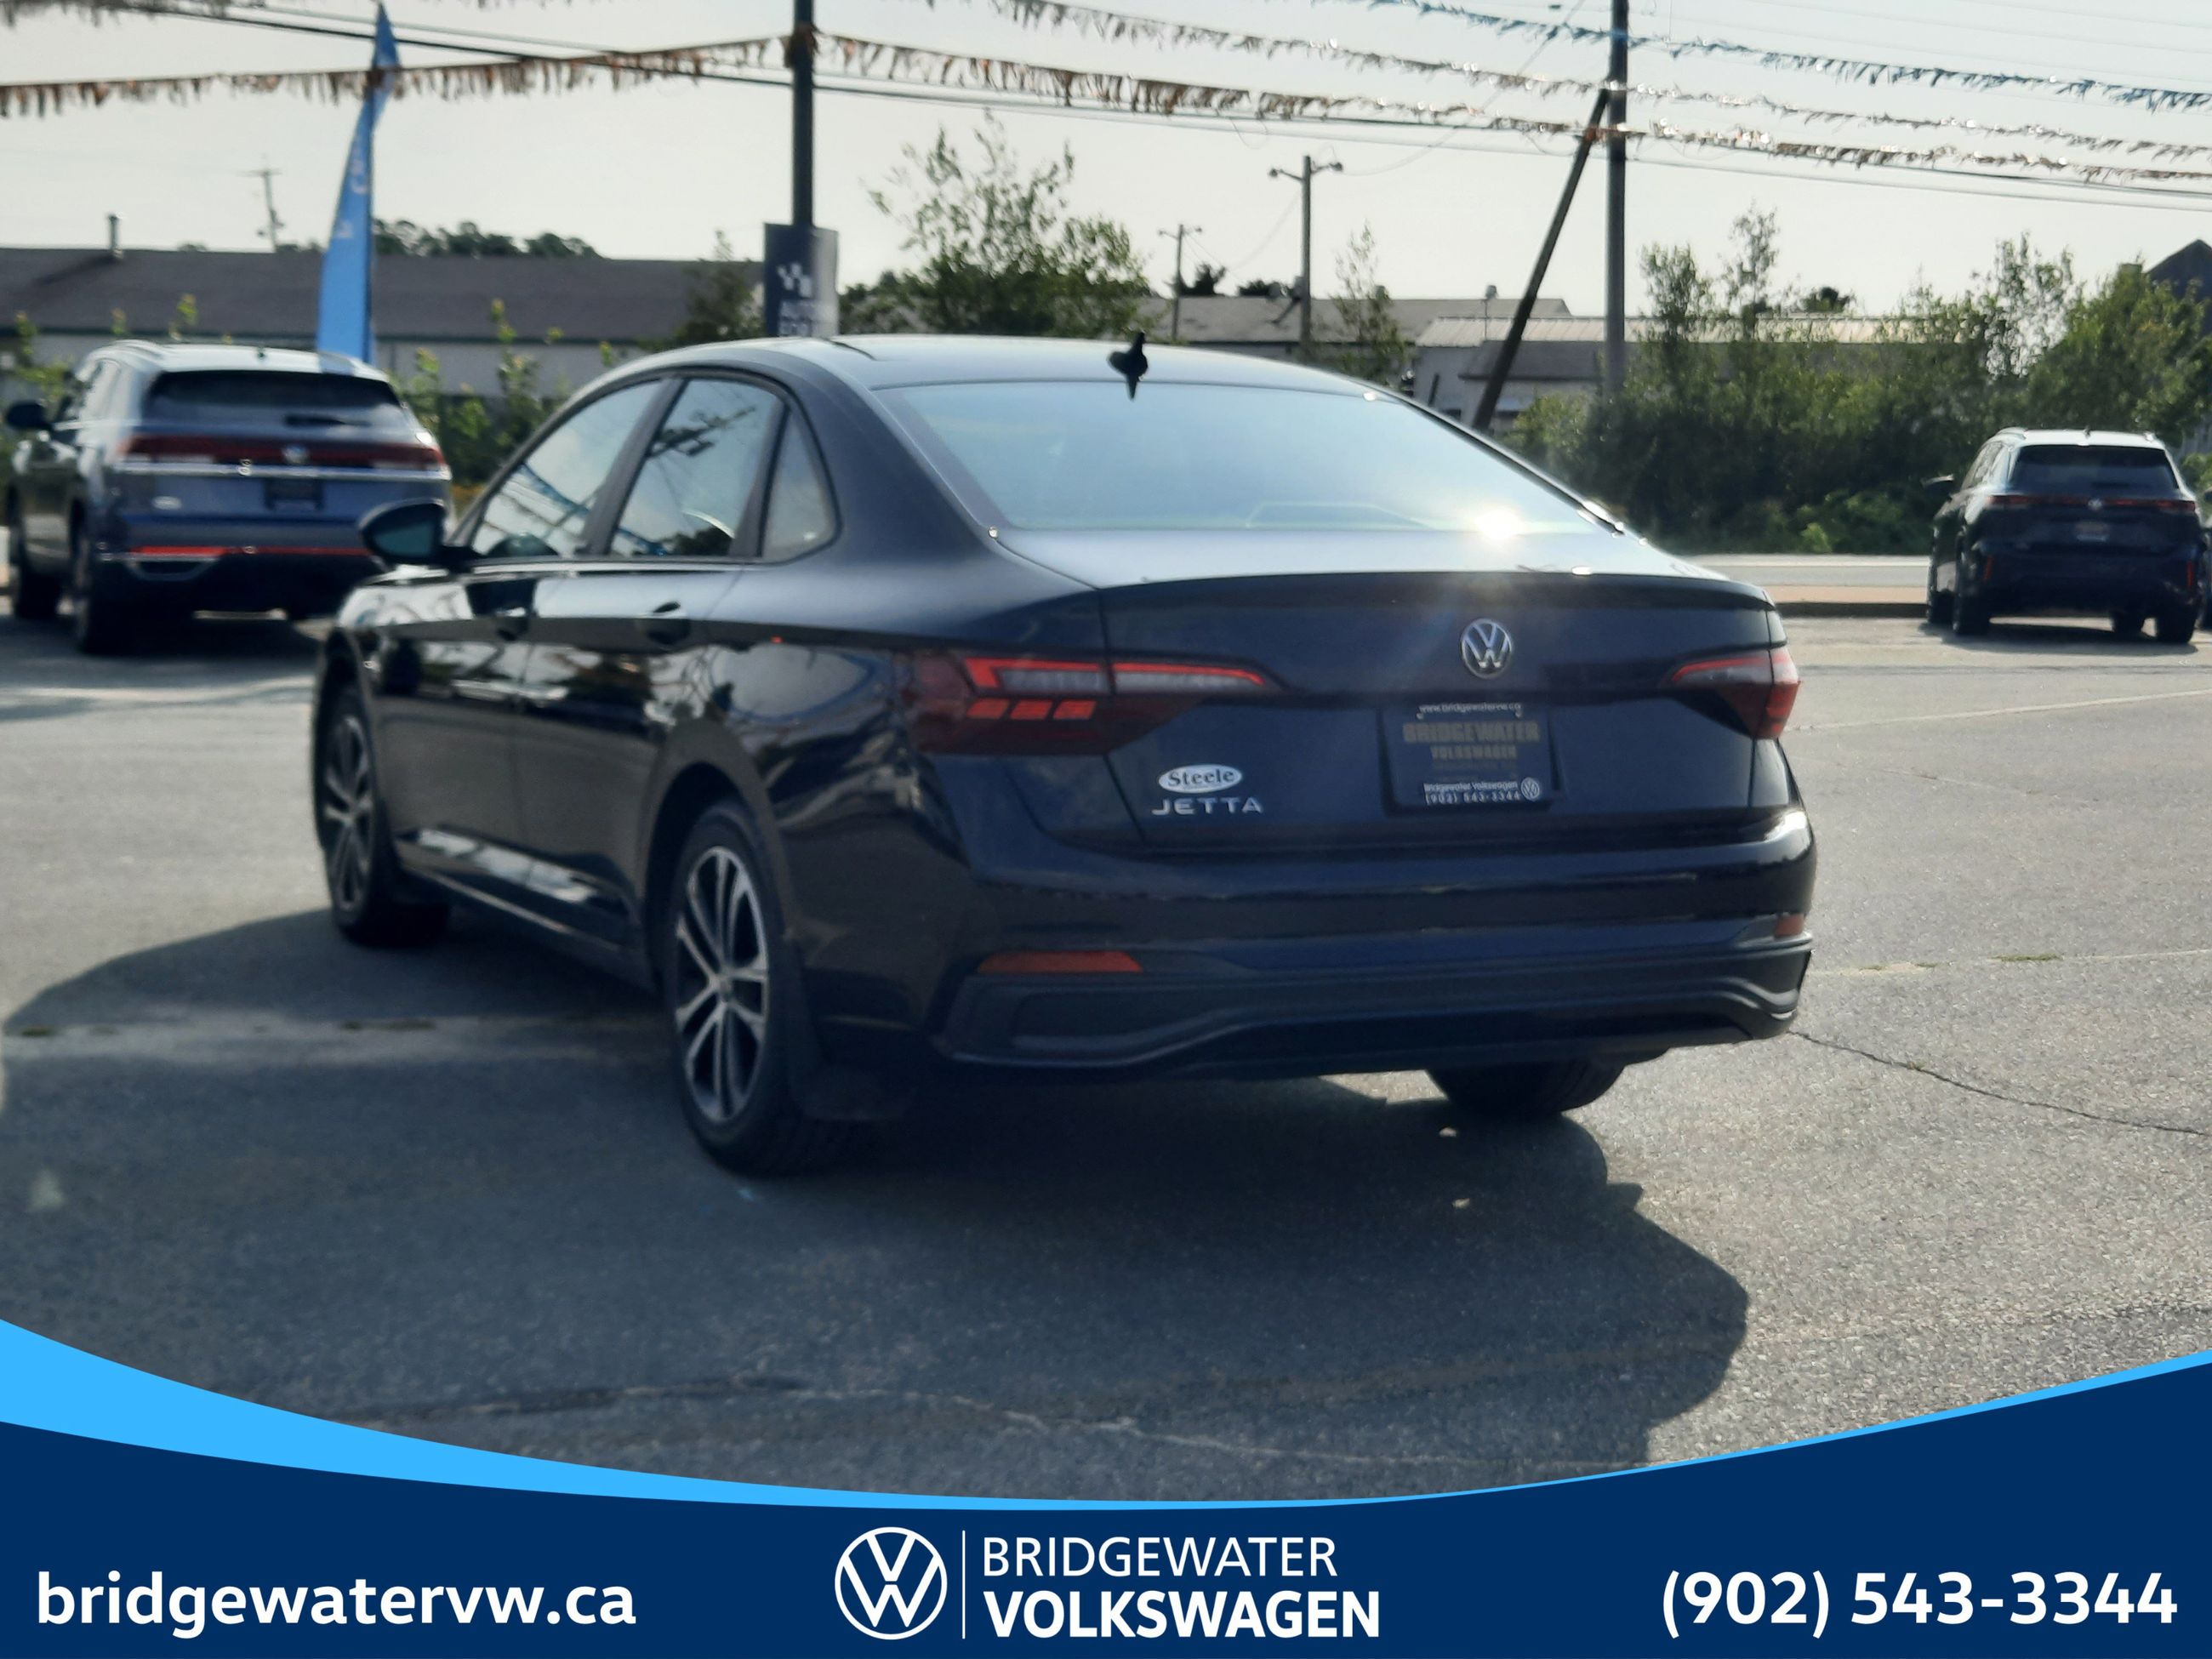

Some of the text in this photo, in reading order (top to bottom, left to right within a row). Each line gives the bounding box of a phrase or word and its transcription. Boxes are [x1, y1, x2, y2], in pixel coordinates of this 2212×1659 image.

[1402, 721, 1541, 743] BRIDGEWATER
[1430, 745, 1518, 760] VOLKSWAGEN
[1167, 768, 1235, 787] Steele
[1151, 796, 1264, 815] JETTA
